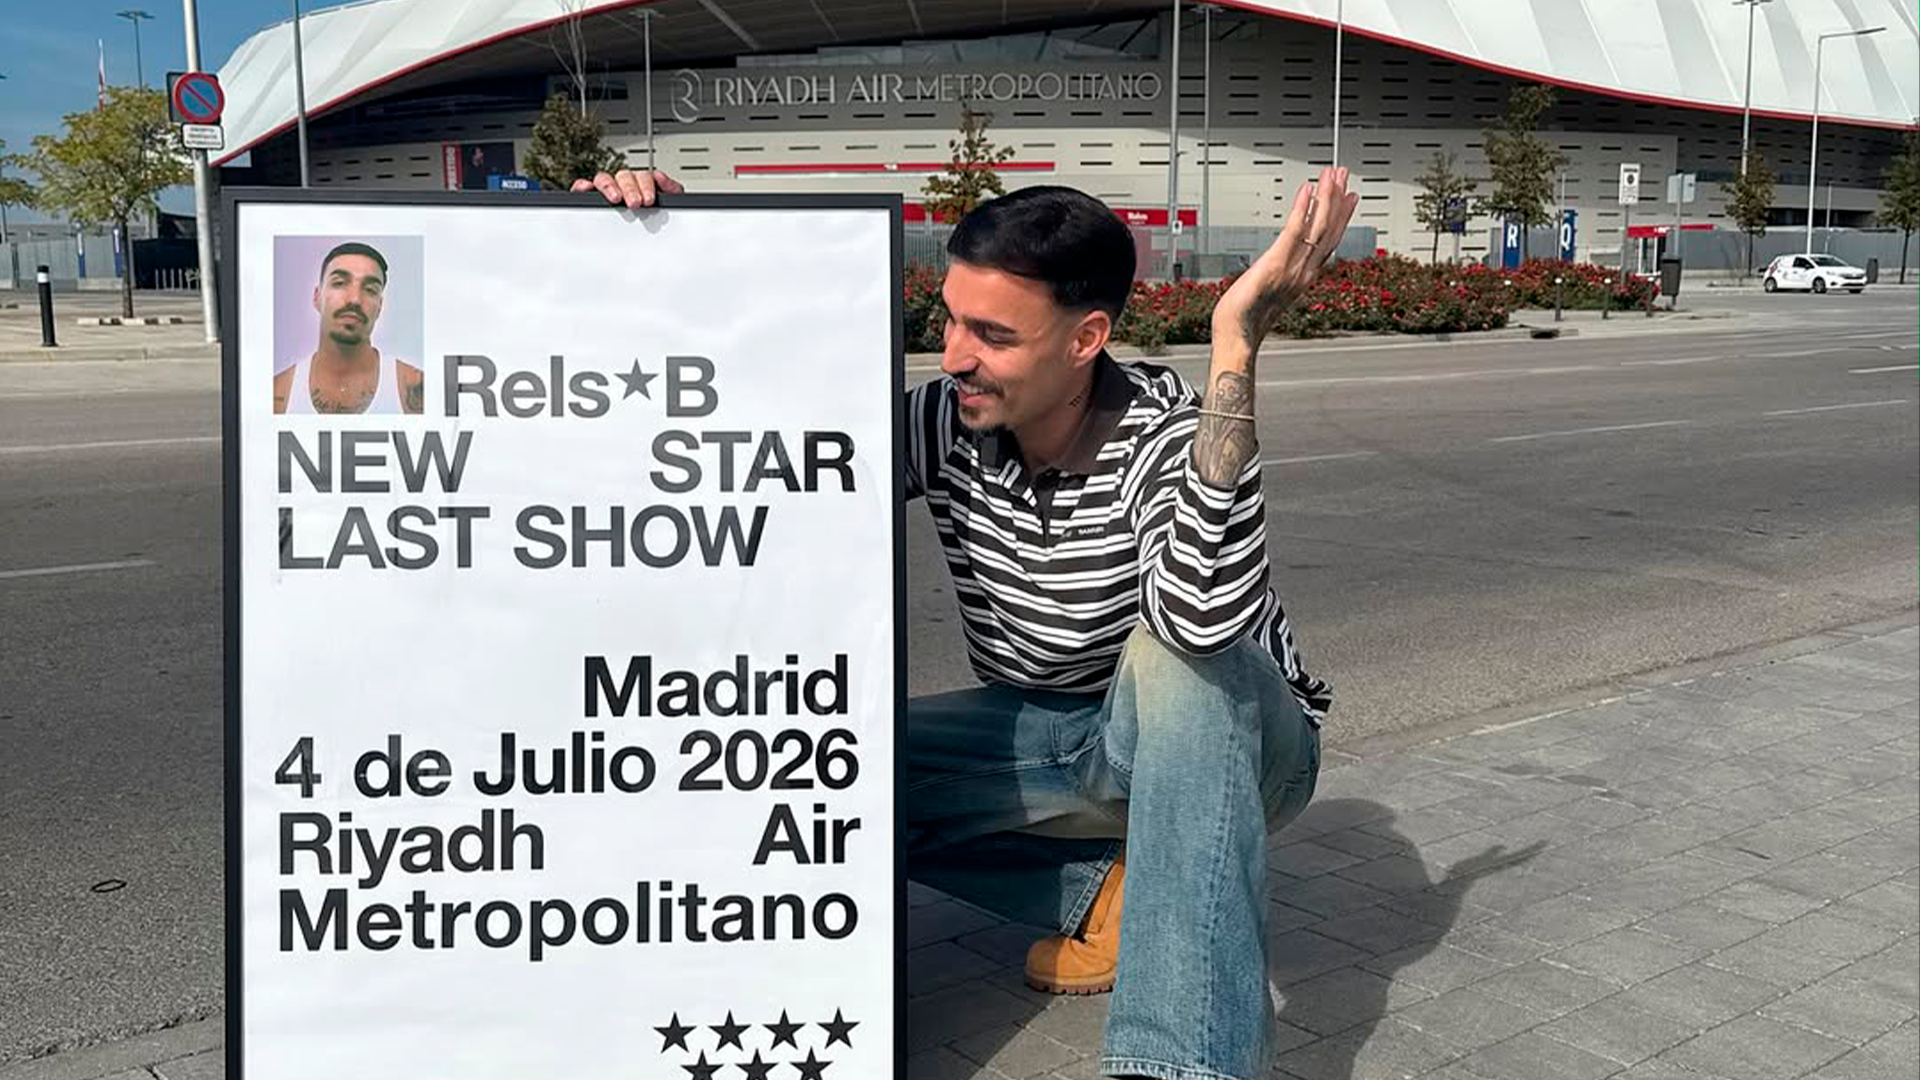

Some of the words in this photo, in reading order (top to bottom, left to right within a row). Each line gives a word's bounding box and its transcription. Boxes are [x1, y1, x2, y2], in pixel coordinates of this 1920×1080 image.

[714, 75, 836, 106] RIYADH
[847, 73, 905, 103] AIR
[915, 72, 1162, 102] METROPOLITANO
[1506, 224, 1519, 249] R
[1560, 222, 1573, 251] Q
[444, 356, 610, 418] Rels
[278, 431, 473, 493] NEW
[650, 430, 856, 493] STAR
[278, 506, 490, 570] LAST
[513, 505, 770, 569] SHOW
[584, 653, 848, 718] Madrid
[274, 736, 322, 799] 4
[354, 734, 453, 799] de
[473, 731, 656, 796] Julio
[678, 728, 860, 792] 2026
[279, 808, 545, 889] Riyadh
[752, 802, 861, 866] Air
[279, 880, 859, 962] Metropolitano
